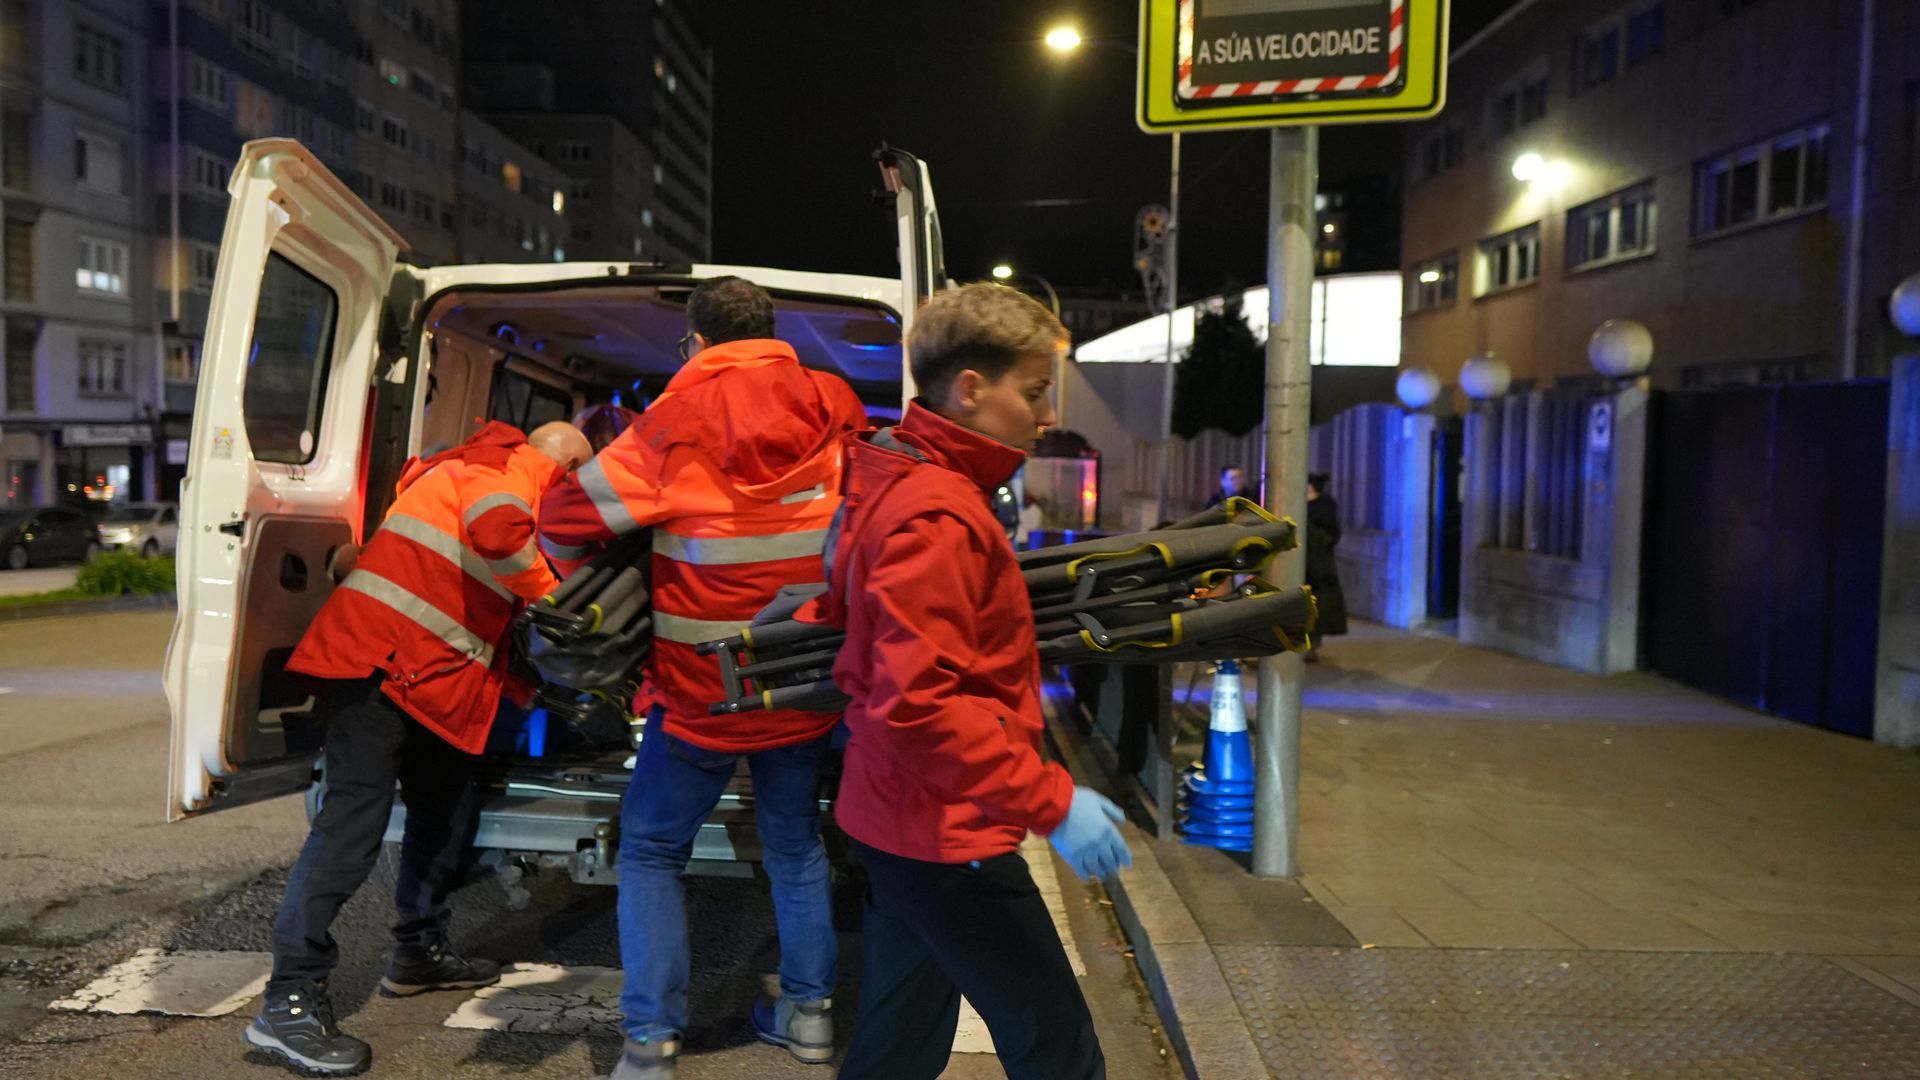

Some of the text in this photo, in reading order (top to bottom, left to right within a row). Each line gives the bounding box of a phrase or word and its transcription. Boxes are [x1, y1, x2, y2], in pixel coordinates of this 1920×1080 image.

[1197, 27, 1380, 64] A SÚA VELOCIDADE
